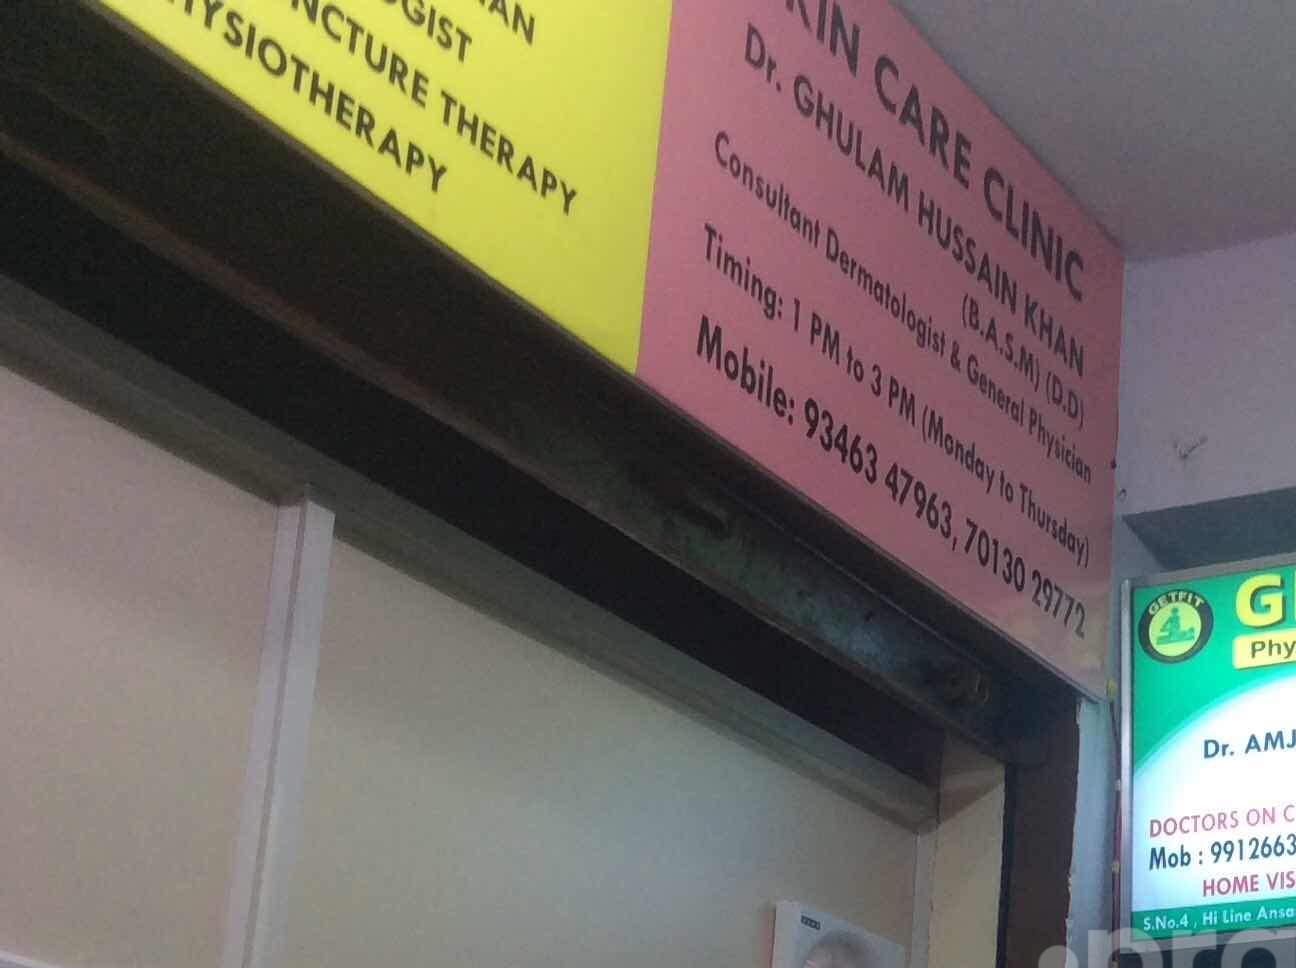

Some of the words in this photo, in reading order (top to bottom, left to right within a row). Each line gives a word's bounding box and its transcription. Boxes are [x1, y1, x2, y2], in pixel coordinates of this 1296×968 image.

[384, 0, 473, 62] GIST
[478, 0, 535, 45] AN
[167, 0, 448, 192] YSIOTHERAPY
[440, 90, 577, 215] THERAPY
[745, 22, 781, 93] Dr.
[793, 74, 910, 213] GHULAM
[917, 191, 1017, 316] HUSSAIN
[1024, 295, 1085, 377] KHAN
[874, 55, 972, 189] CARE
[983, 167, 1085, 302] CLINIC
[714, 131, 821, 249] Consultant
[825, 229, 946, 358] Dermatologist
[950, 341, 962, 373] &
[966, 355, 1025, 426] General
[1028, 407, 1092, 485] Physician
[961, 293, 1041, 393] (B.A.S.M)
[1045, 370, 1085, 430] (D.D)
[703, 223, 783, 321] Timing:
[792, 298, 801, 333] 1
[810, 312, 841, 363] PM
[846, 344, 865, 384] to
[870, 364, 883, 398] 3
[888, 380, 917, 427] PM
[921, 404, 996, 493] (Monday
[1000, 471, 1015, 503] to
[1019, 485, 1090, 569] Thursday)
[696, 316, 795, 426] Mobile:
[804, 398, 878, 485] 93463
[885, 462, 958, 552] 47963,
[965, 518, 1027, 593] 70130
[1031, 574, 1086, 640] 29772
[1148, 590, 1205, 616] GETFIT
[1203, 739, 1236, 760] Dr.
[1149, 810, 1240, 839] DOCTORS
[1246, 807, 1277, 827] ON
[1202, 874, 1260, 897] HOME
[1203, 910, 1218, 927] Hi
[1221, 906, 1251, 924] Line
